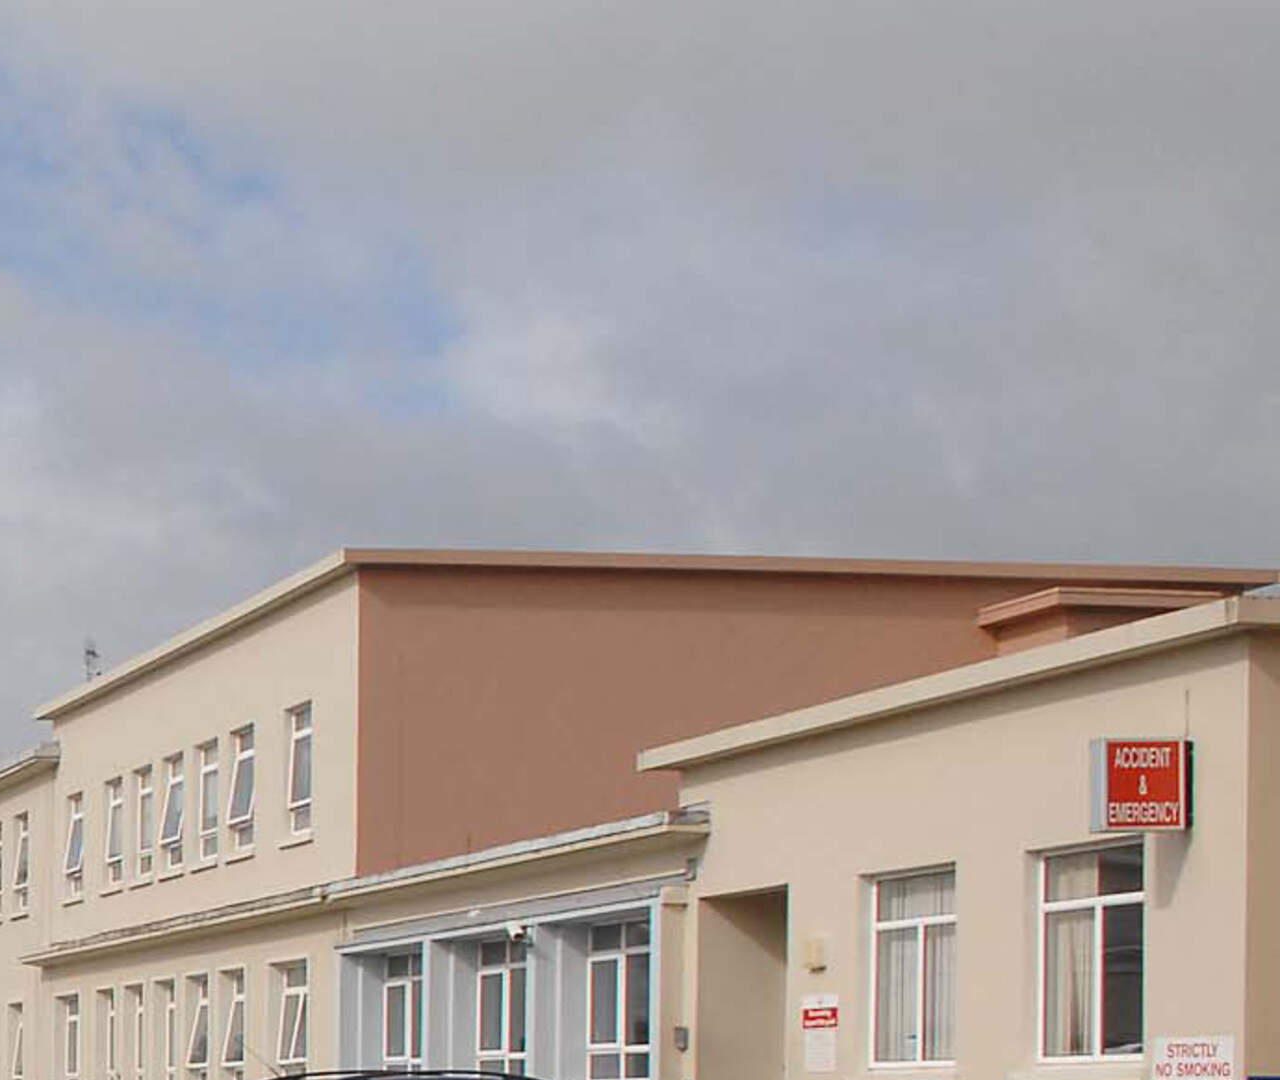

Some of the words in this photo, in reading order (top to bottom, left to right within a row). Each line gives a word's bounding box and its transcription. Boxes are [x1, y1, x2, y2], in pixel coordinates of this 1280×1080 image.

[1114, 747, 1170, 769] ACCIDENT
[1109, 801, 1180, 823] EMERGENCY
[1166, 1043, 1219, 1058] STRICTLY
[1155, 1062, 1172, 1076] NO
[1177, 1062, 1231, 1076] SMOKING
